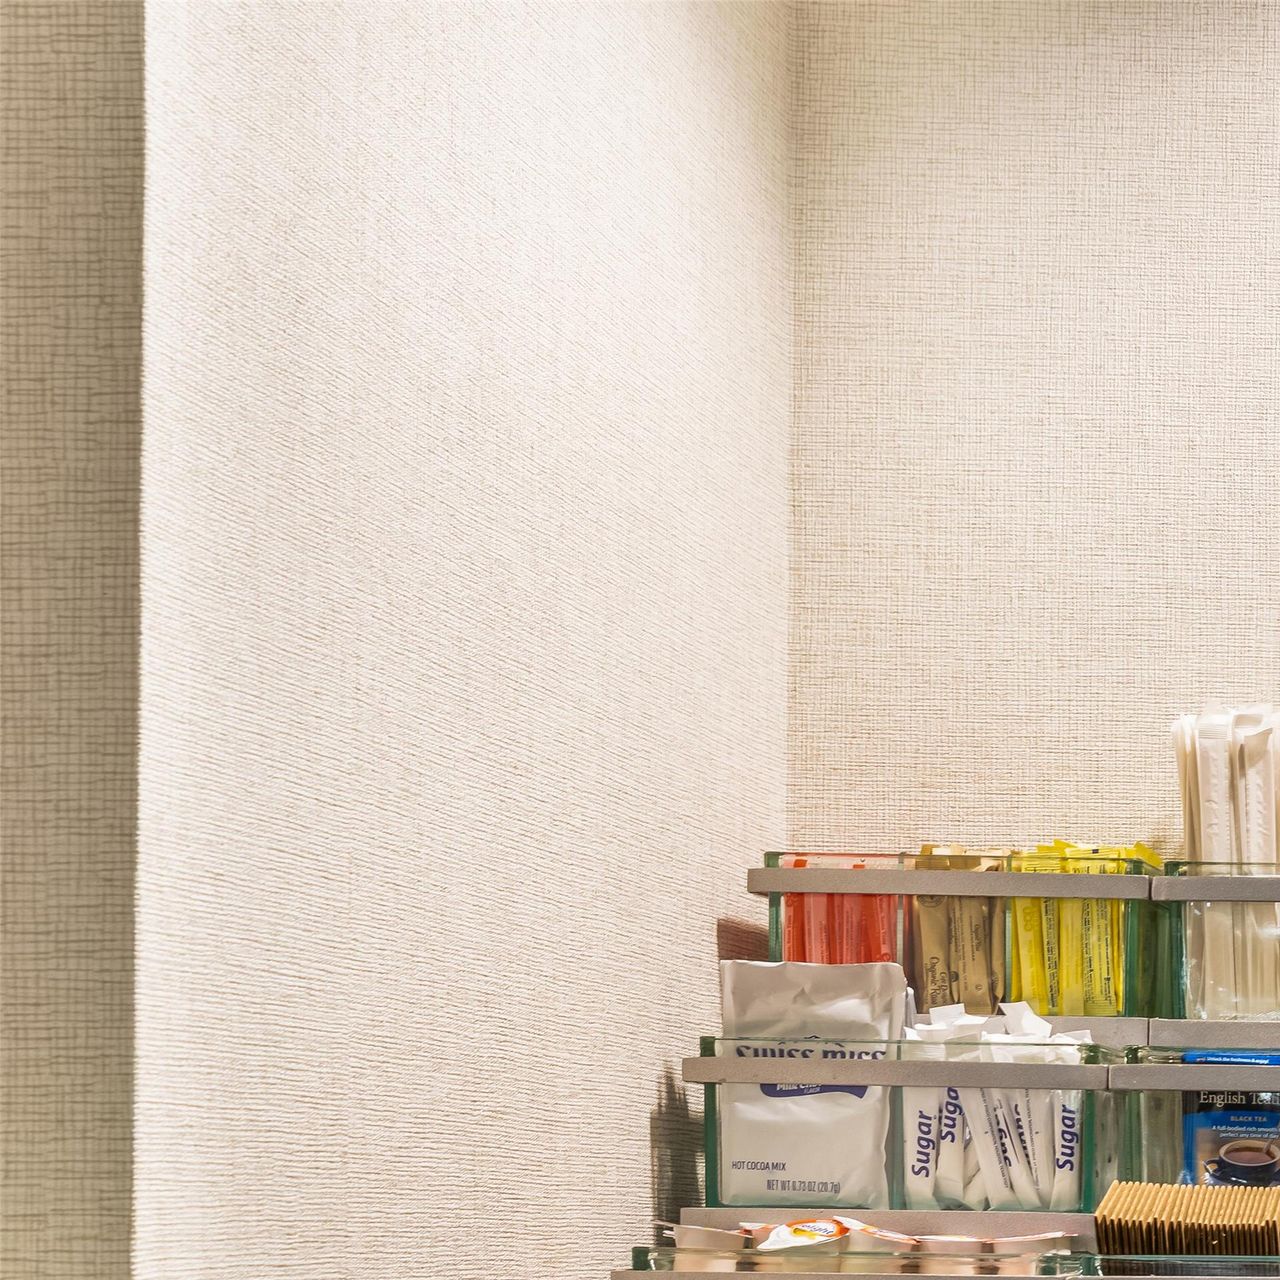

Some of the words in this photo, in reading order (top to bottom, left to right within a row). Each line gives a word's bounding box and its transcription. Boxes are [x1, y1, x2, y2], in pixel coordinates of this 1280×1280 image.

[940, 1086, 965, 1143] Suga
[1200, 1091, 1247, 1107] English
[911, 1110, 936, 1178] Sugar
[1056, 1103, 1079, 1172] Sugar
[731, 1160, 746, 1170] HOT
[746, 1161, 771, 1171] COCOA
[771, 1161, 787, 1171] MIX
[766, 1179, 779, 1191] NET
[780, 1180, 791, 1191] WT
